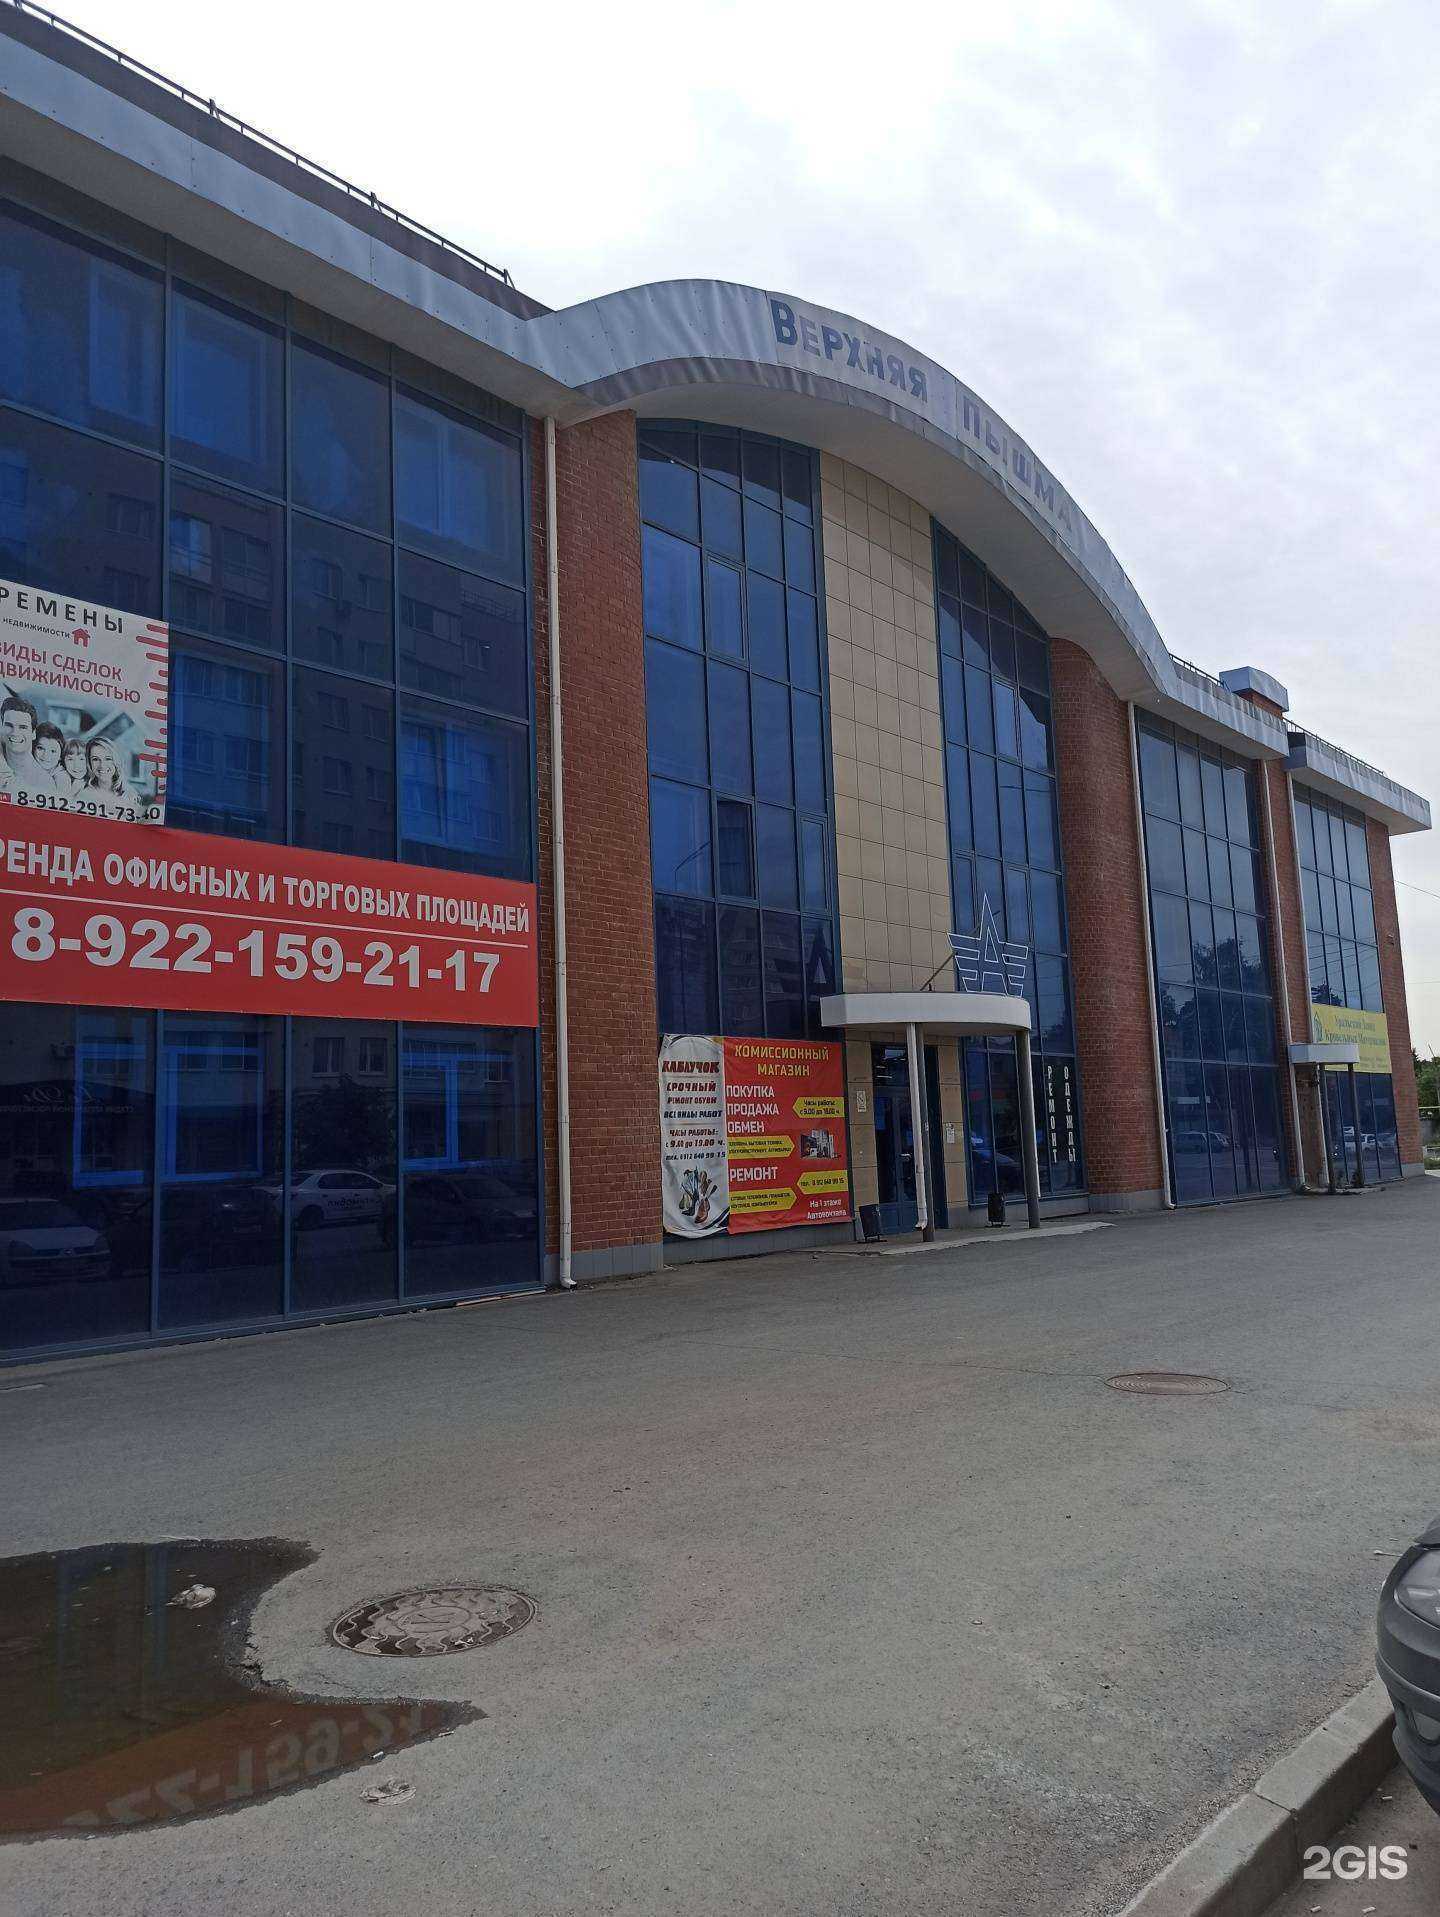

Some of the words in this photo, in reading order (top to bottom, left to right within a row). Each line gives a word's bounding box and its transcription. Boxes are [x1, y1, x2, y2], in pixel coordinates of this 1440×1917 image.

[0, 642, 47, 665] ИДЫ
[52, 652, 123, 682] СДЕЛОК
[104, 852, 251, 901] ОФИСНЫХ
[258, 875, 276, 904] И
[283, 877, 410, 920] ТОРГОВЫХ
[415, 894, 530, 934] ПЛОЩАДЕЙ
[11, 907, 501, 993] 8-922-159-21-17
[735, 1044, 829, 1061] КОМИССИОННЫЙ
[661, 1060, 720, 1073] КАБЛУЧОК
[757, 1064, 810, 1076] МАГАЗИН
[666, 1081, 717, 1092] СРОЧНЫЙ
[726, 1085, 775, 1098] ПОКУПКА
[667, 1097, 692, 1105] РЕМОНТ
[694, 1096, 717, 1104] ОБУВИ
[663, 1110, 677, 1119] ВСЕ
[678, 1110, 698, 1119] ВИДЫ
[699, 1109, 723, 1118] РАБОТ
[727, 1103, 780, 1117] ПРОДАЖА
[1047, 1065, 1057, 1163] РЕМОНТ
[1063, 1065, 1076, 1162] ОДЕЖДЫ
[669, 1129, 687, 1137] ЧАСЫ
[727, 1121, 765, 1134] ОБМЕН
[729, 1166, 778, 1182] РЕМОНТ
